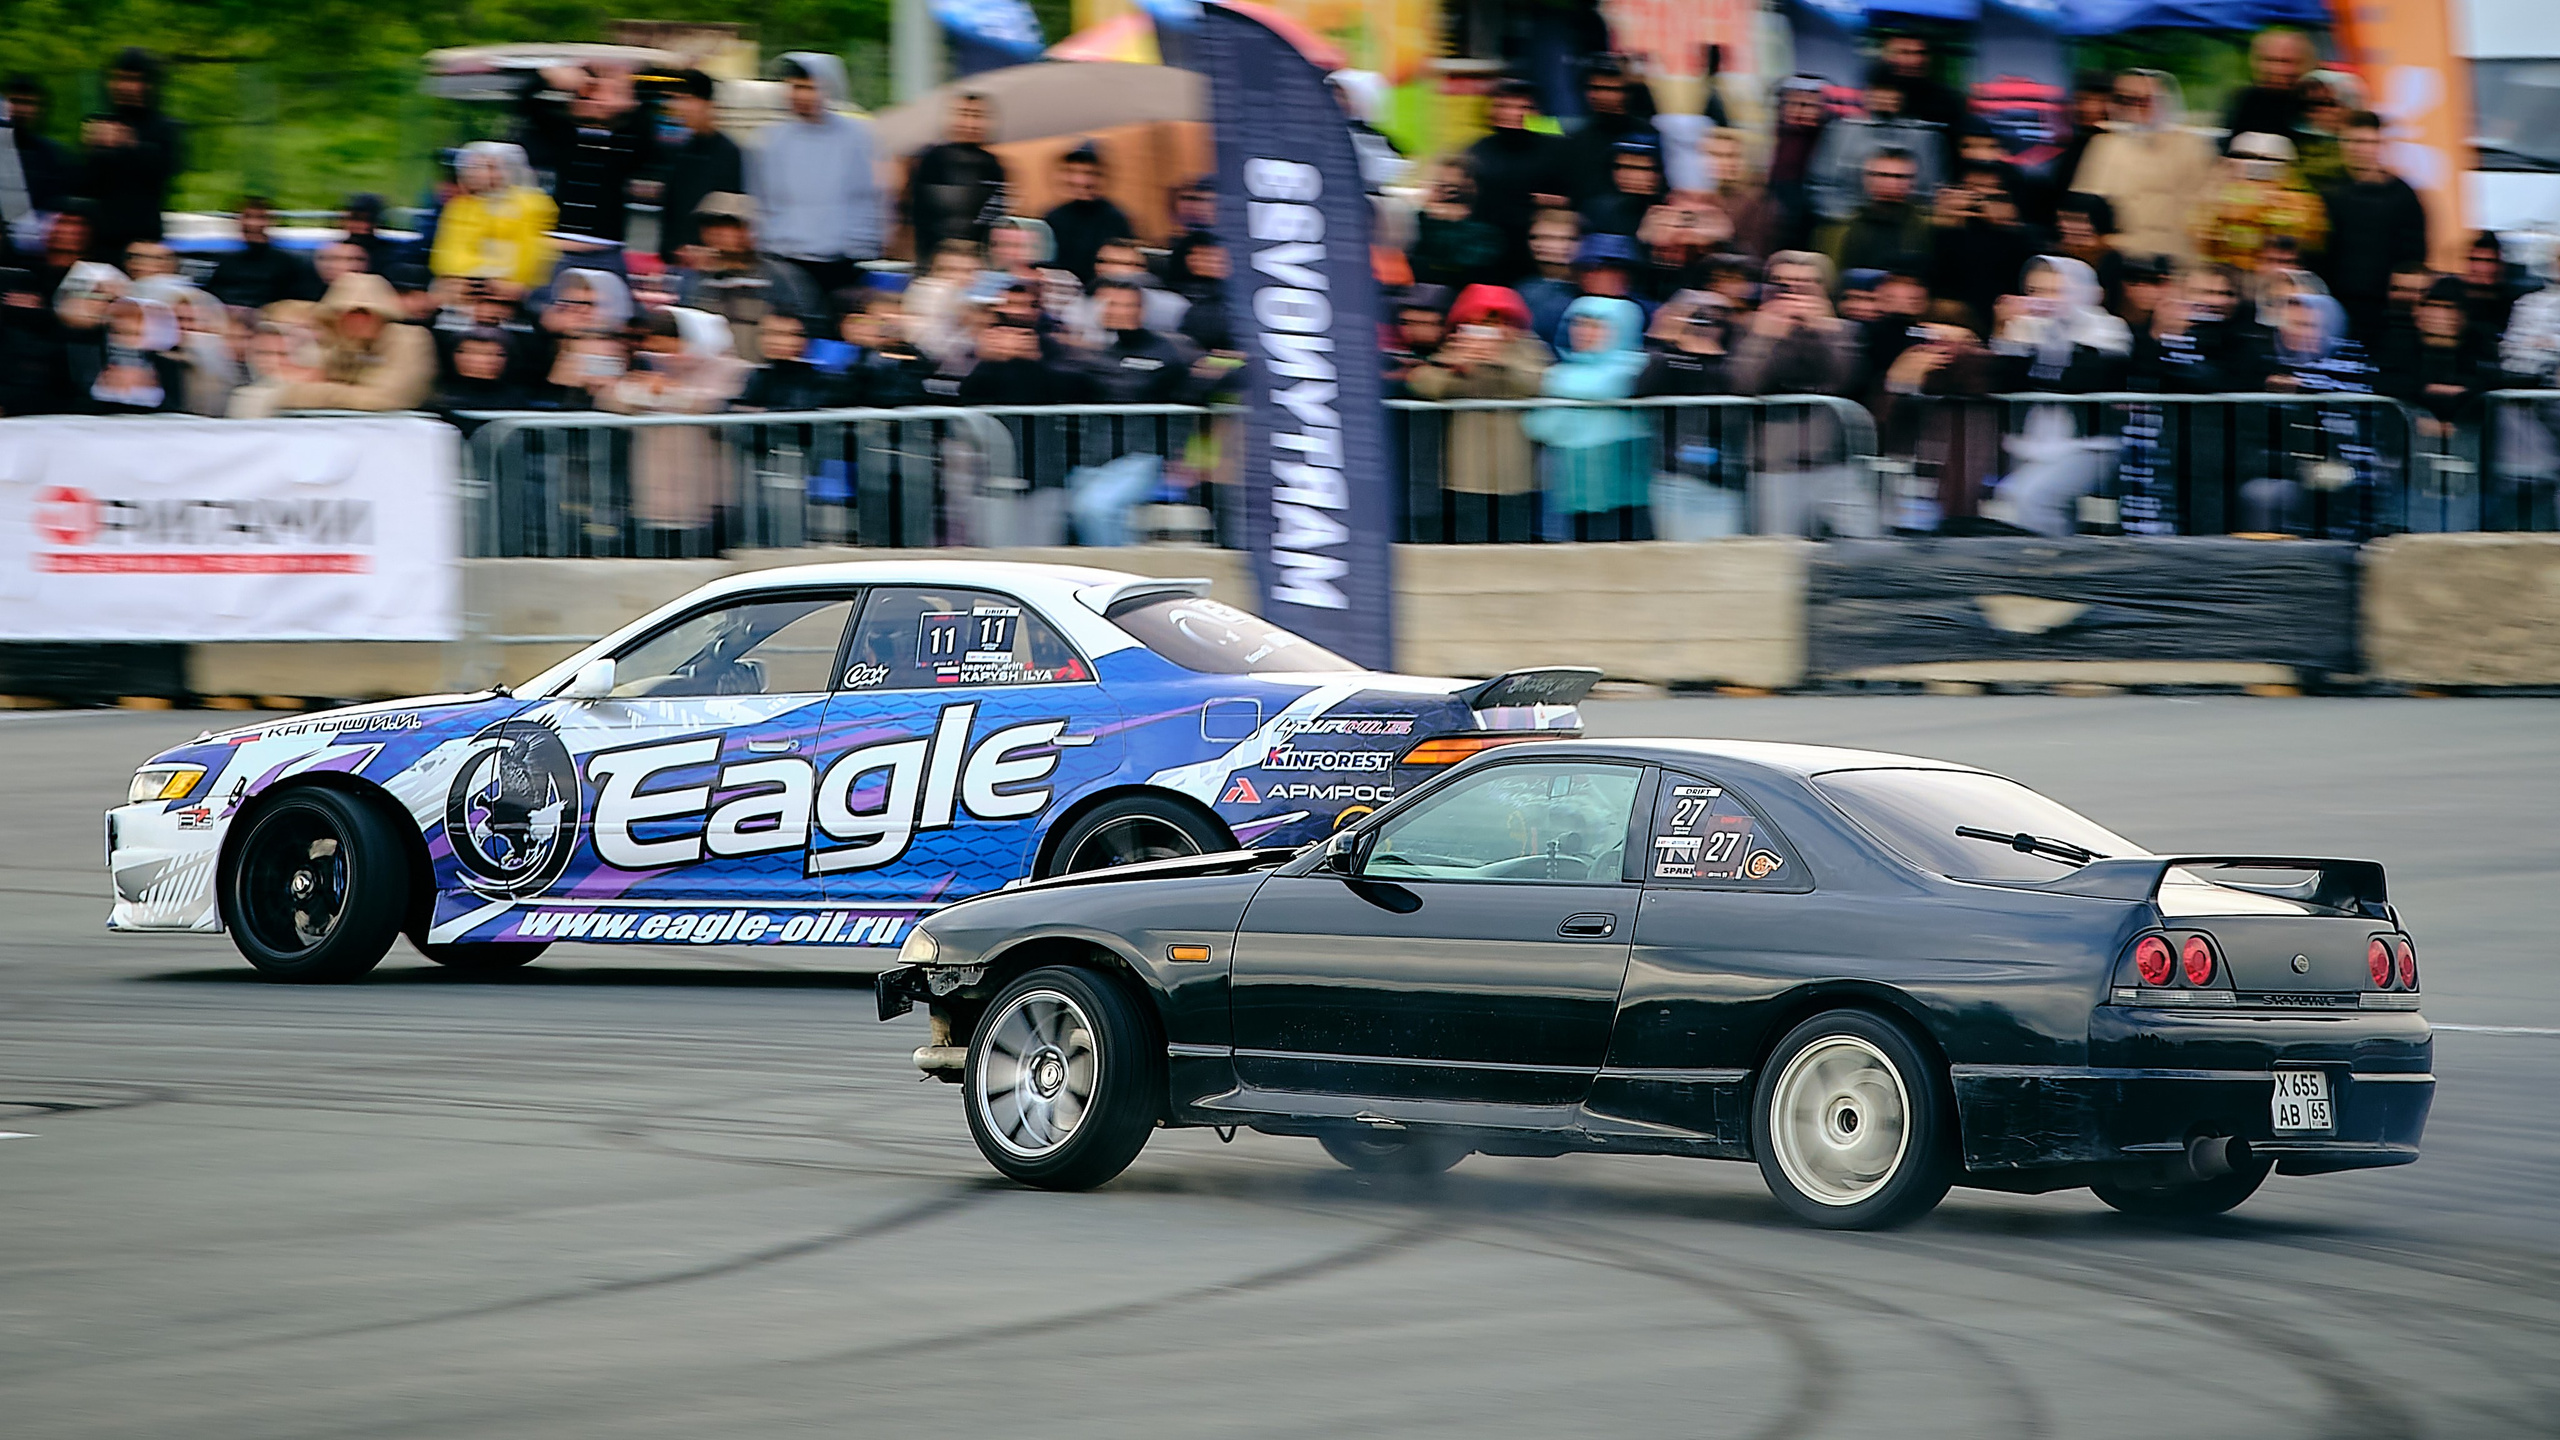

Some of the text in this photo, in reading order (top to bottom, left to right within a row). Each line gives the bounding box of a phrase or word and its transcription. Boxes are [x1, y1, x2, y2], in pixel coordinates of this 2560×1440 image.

[931, 627, 955, 654] 11
[981, 618, 1005, 643] 11
[960, 670, 1052, 682] KAPYSH ILYA
[1265, 745, 1392, 768] KINFOREST
[586, 700, 1072, 878] Eagle
[1671, 799, 1707, 826] 27
[1705, 831, 1741, 861] 27
[517, 909, 904, 944] www.eagle-oil.ru
[2262, 995, 2336, 1007] SKYLINE
[2293, 1074, 2319, 1096] 655
[2311, 1102, 2326, 1120] 65
